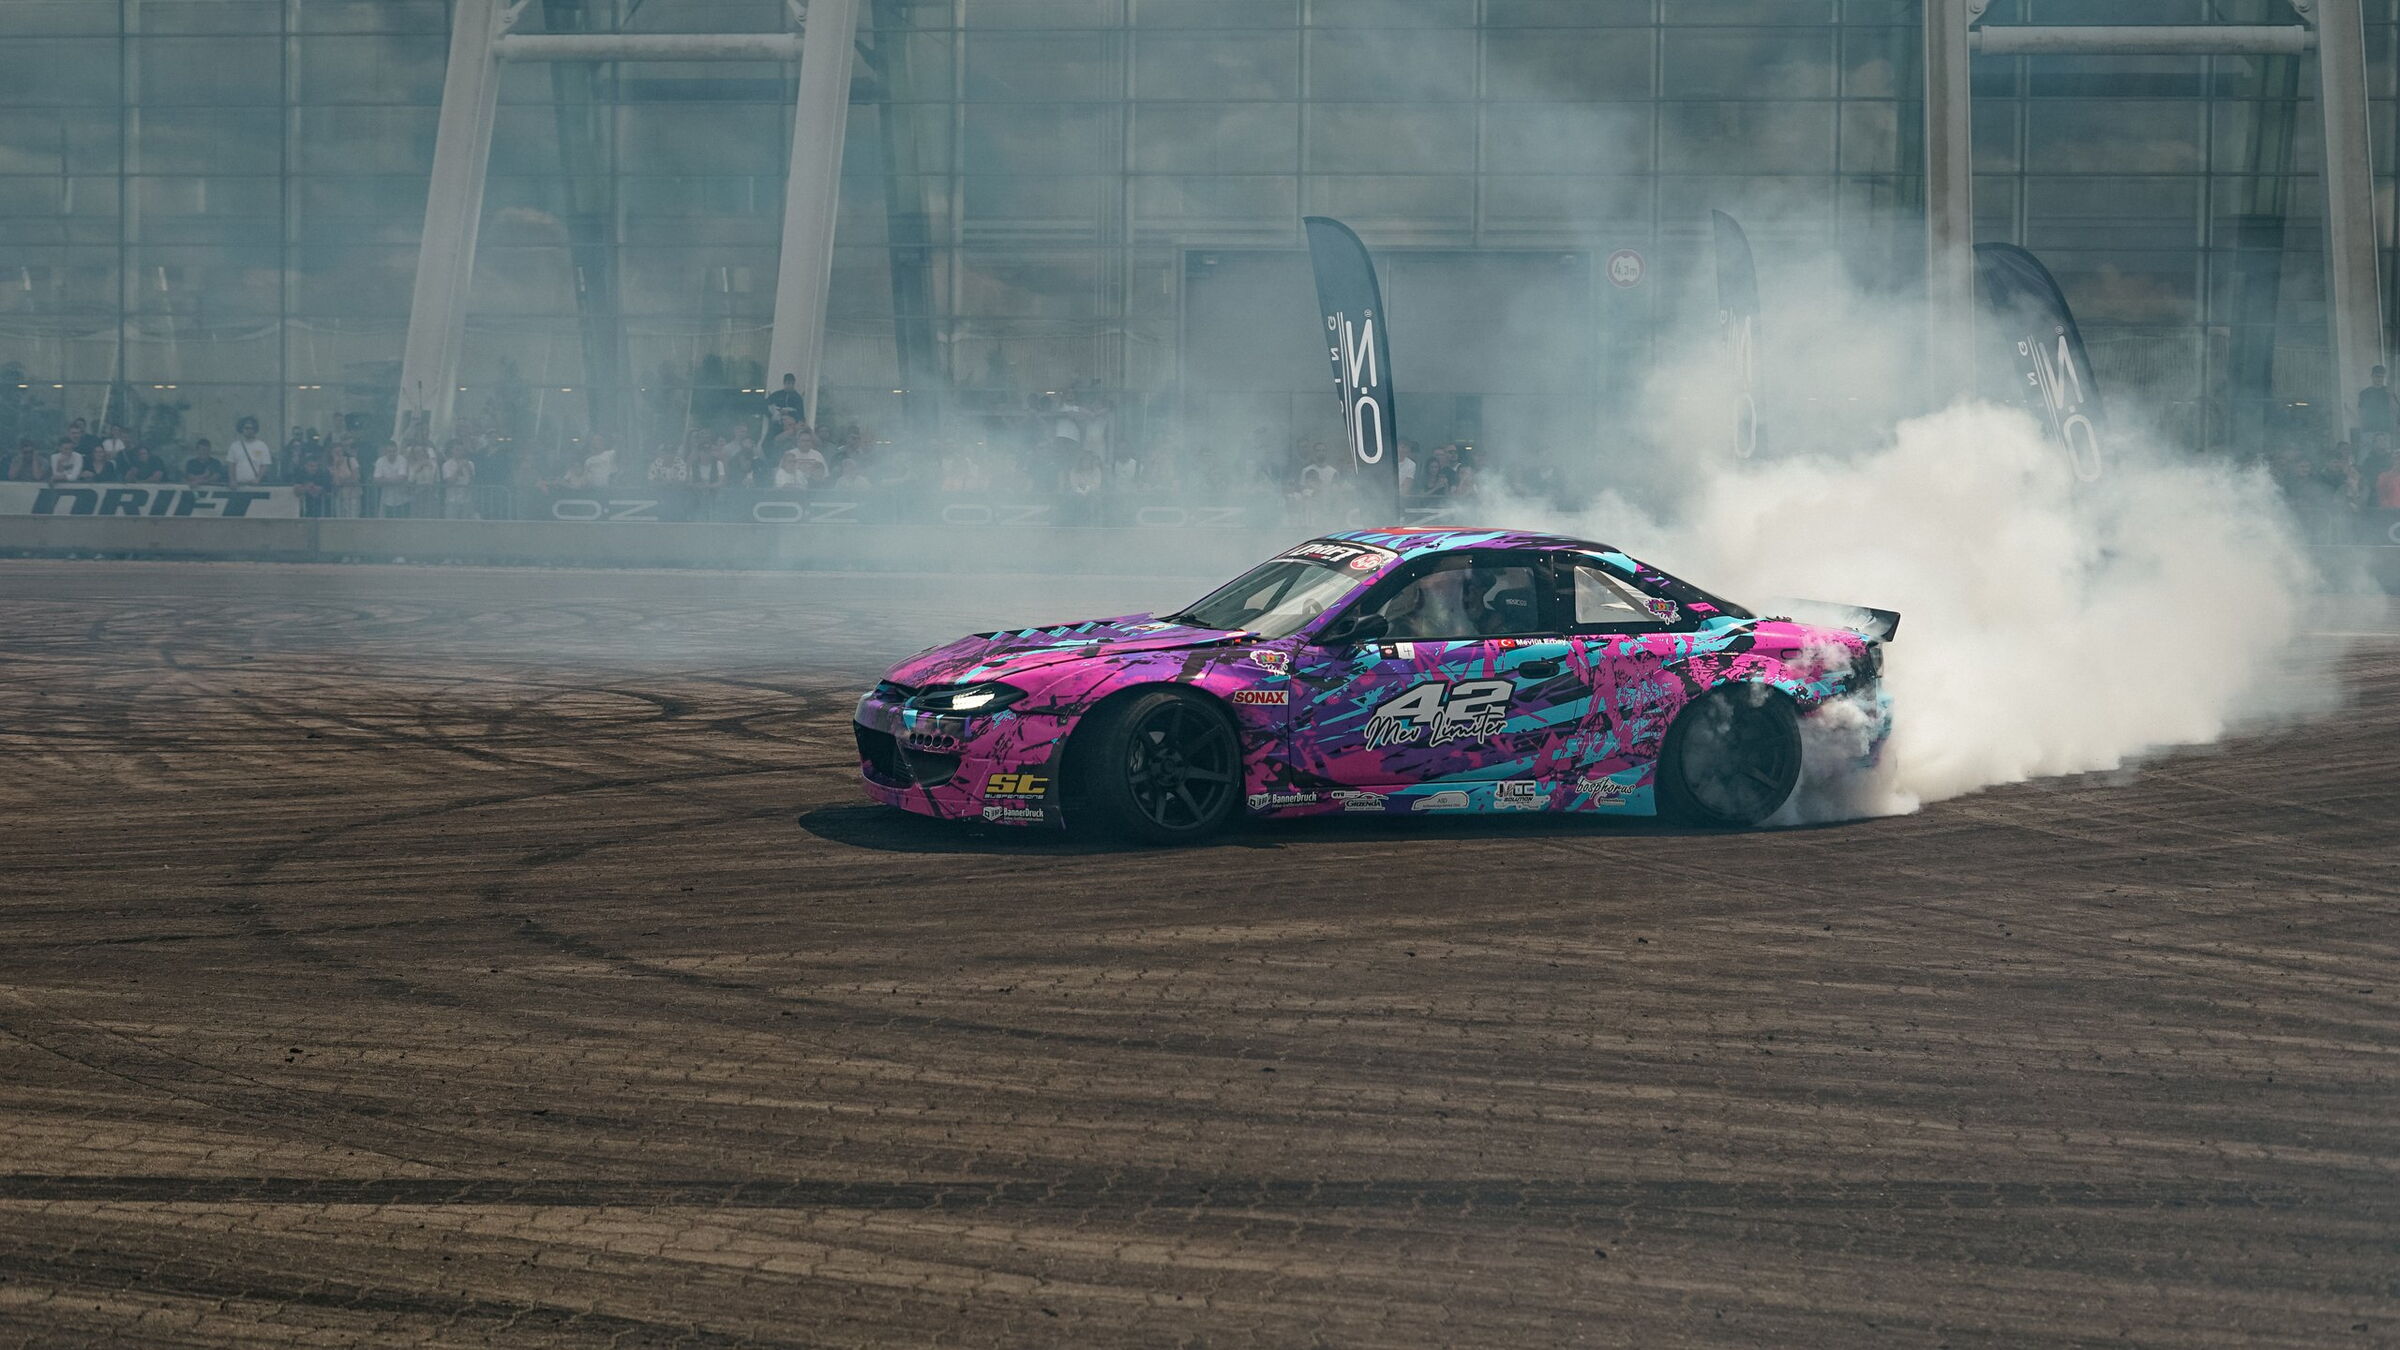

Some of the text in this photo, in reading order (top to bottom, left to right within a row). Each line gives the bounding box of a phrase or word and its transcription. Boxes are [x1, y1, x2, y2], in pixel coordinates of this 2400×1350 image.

[31, 488, 271, 517] DRIFT
[1234, 691, 1286, 704] SONAX
[1375, 680, 1515, 723] 42
[1365, 705, 1507, 751] Mev Limiter
[1272, 791, 1318, 804] BannerDruck
[1003, 808, 1044, 818] BannerDruck
